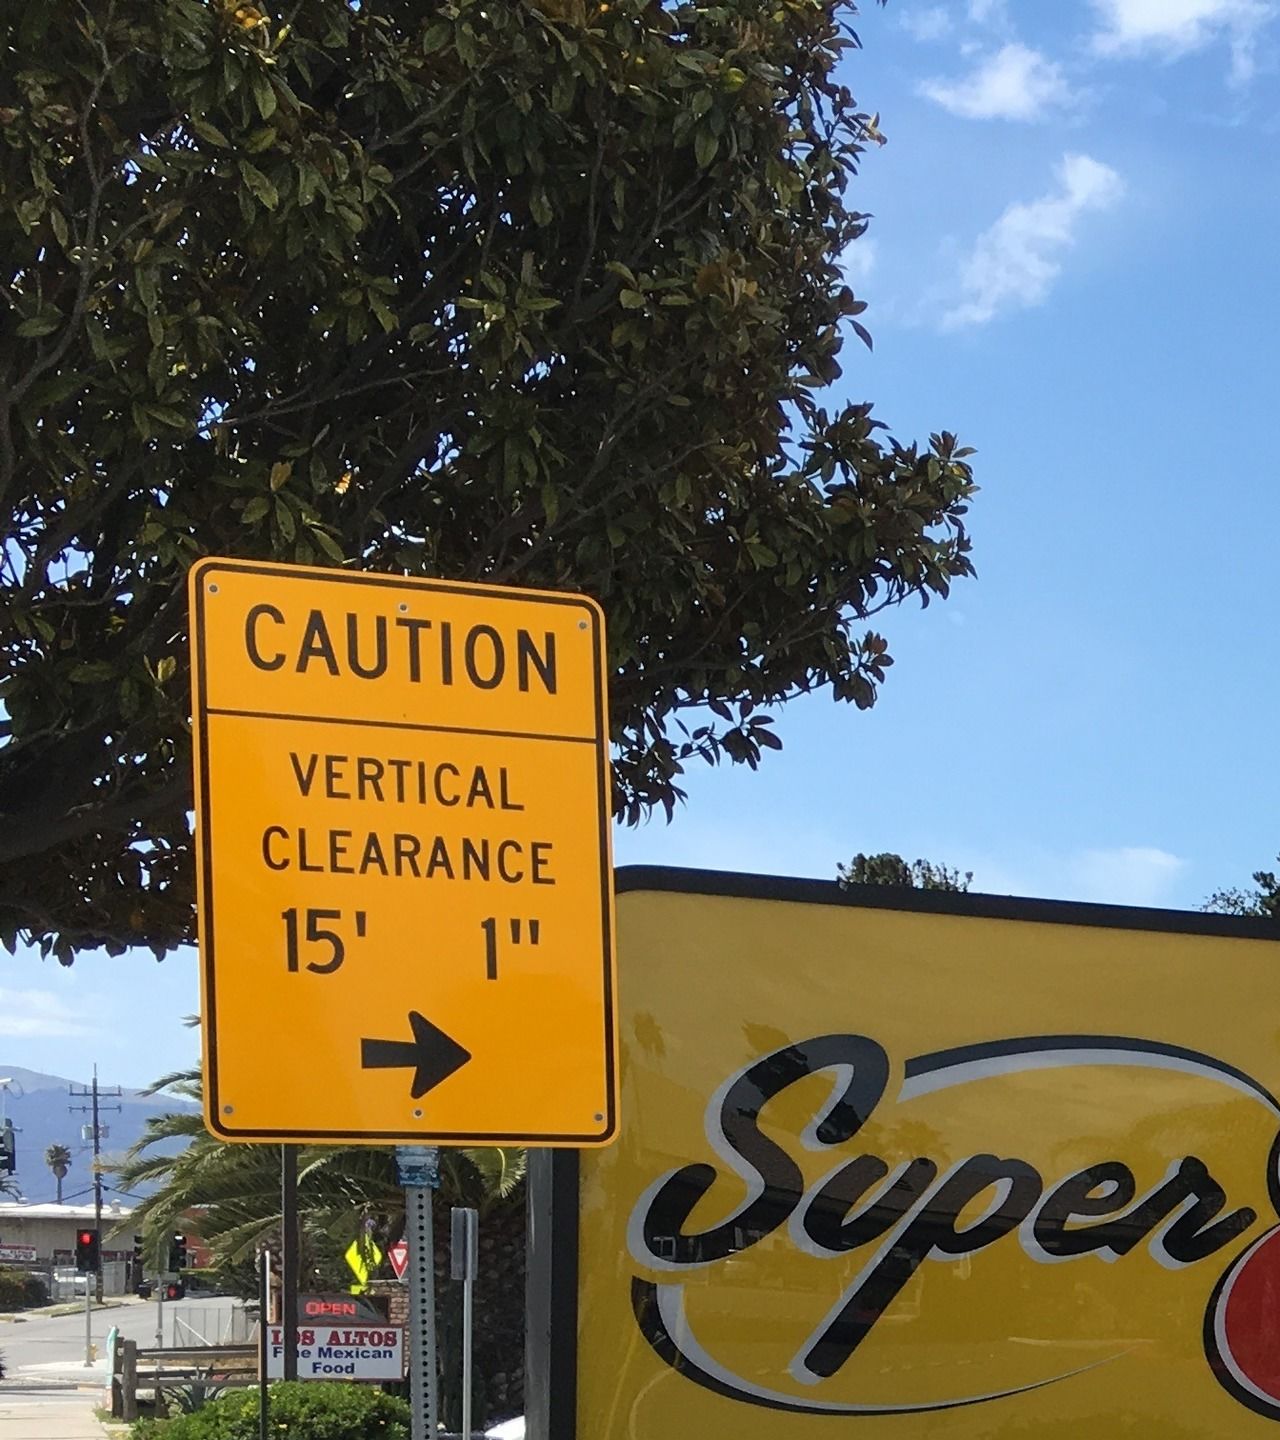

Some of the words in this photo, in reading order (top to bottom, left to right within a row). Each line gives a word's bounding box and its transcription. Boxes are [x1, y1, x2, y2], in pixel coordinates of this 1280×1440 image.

[245, 603, 558, 695] CAUTION
[290, 752, 525, 811] VERTICAL
[262, 825, 556, 885] CLEARANCE
[282, 907, 367, 974] 15'
[626, 1034, 1256, 1384] Super
[305, 1301, 357, 1315] OPEN
[312, 1362, 355, 1374] Food
[318, 1347, 393, 1359] Mexican
[326, 1331, 398, 1347] ALTOS
